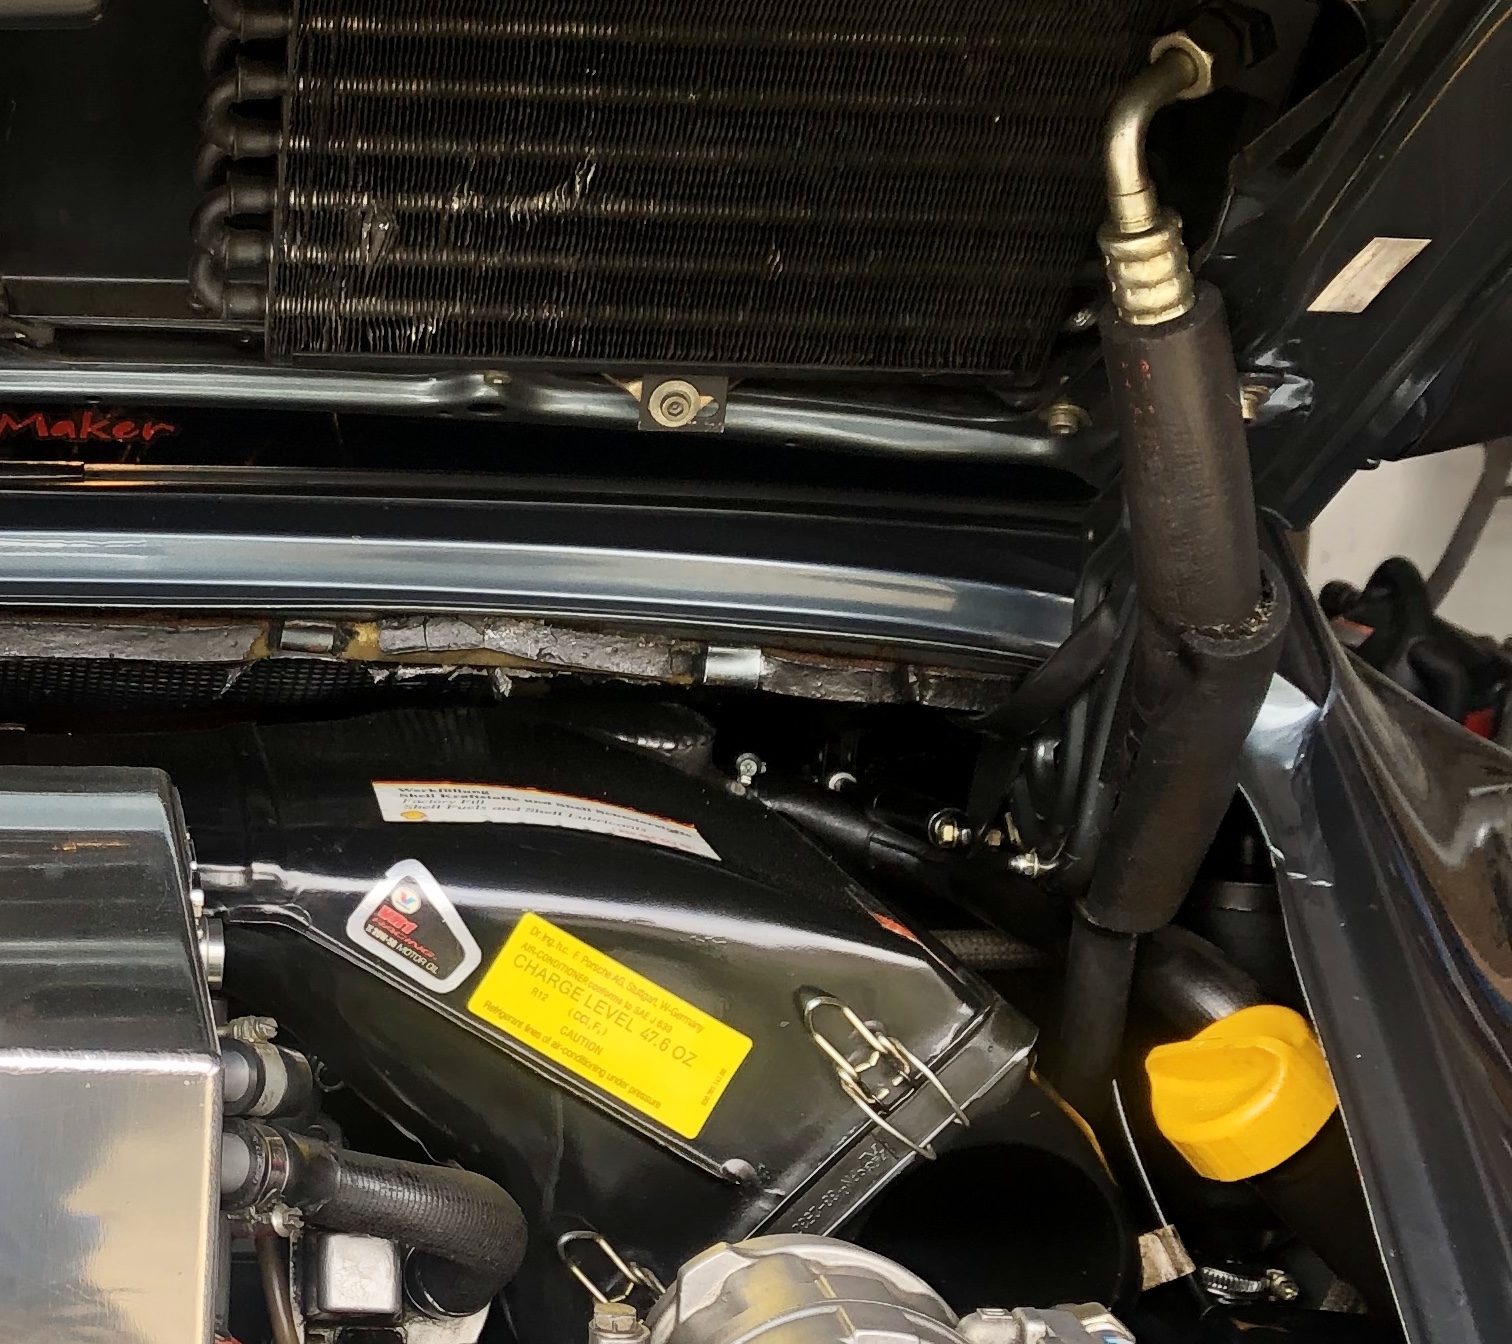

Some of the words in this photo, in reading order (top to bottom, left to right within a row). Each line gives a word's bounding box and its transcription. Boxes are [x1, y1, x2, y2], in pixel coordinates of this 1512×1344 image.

[396, 944, 427, 966] MOTOR
[425, 962, 439, 974] OIL
[530, 987, 549, 1002] R12
[580, 955, 612, 978] Porsche
[660, 1000, 705, 1034] W-Germany
[513, 954, 585, 1002] CHARGE
[583, 993, 634, 1034] LEVEL
[640, 1027, 671, 1052] 47.6
[672, 1045, 698, 1068] OZ
[624, 1000, 632, 1011] to
[633, 1006, 651, 1021] SAE
[484, 1000, 524, 1029] Refrigerant
[541, 1035, 552, 1043] of
[550, 1040, 606, 1078] air-conditioning
[606, 1073, 629, 1088] under
[628, 1085, 662, 1110] pressure
[559, 1025, 604, 1056] CAUTION
